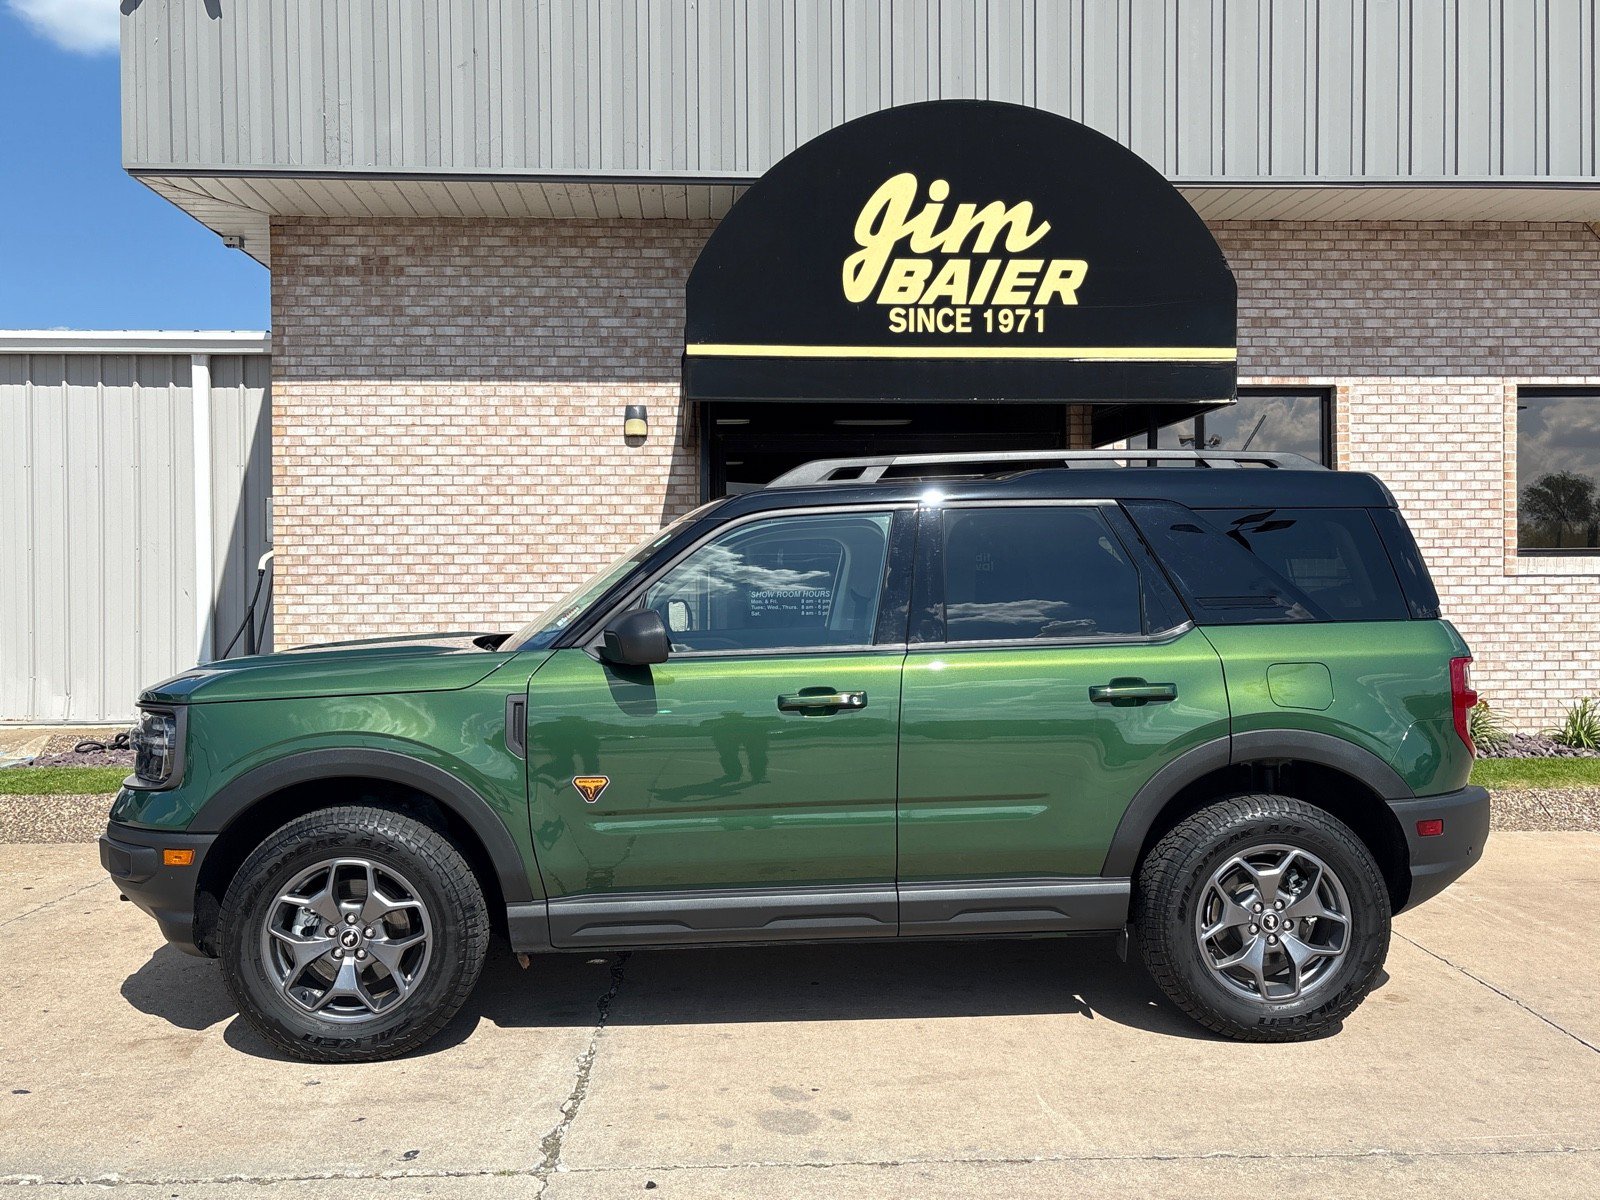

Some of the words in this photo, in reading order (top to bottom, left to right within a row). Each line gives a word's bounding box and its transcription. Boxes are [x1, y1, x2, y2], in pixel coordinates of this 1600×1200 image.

[842, 172, 1052, 303] Jim
[876, 258, 1089, 306] BAIER
[888, 307, 972, 334] SINCE
[983, 308, 1044, 333] 1971
[751, 590, 774, 598] SHOW
[776, 590, 801, 598] ROOM
[802, 590, 831, 598] HOURS
